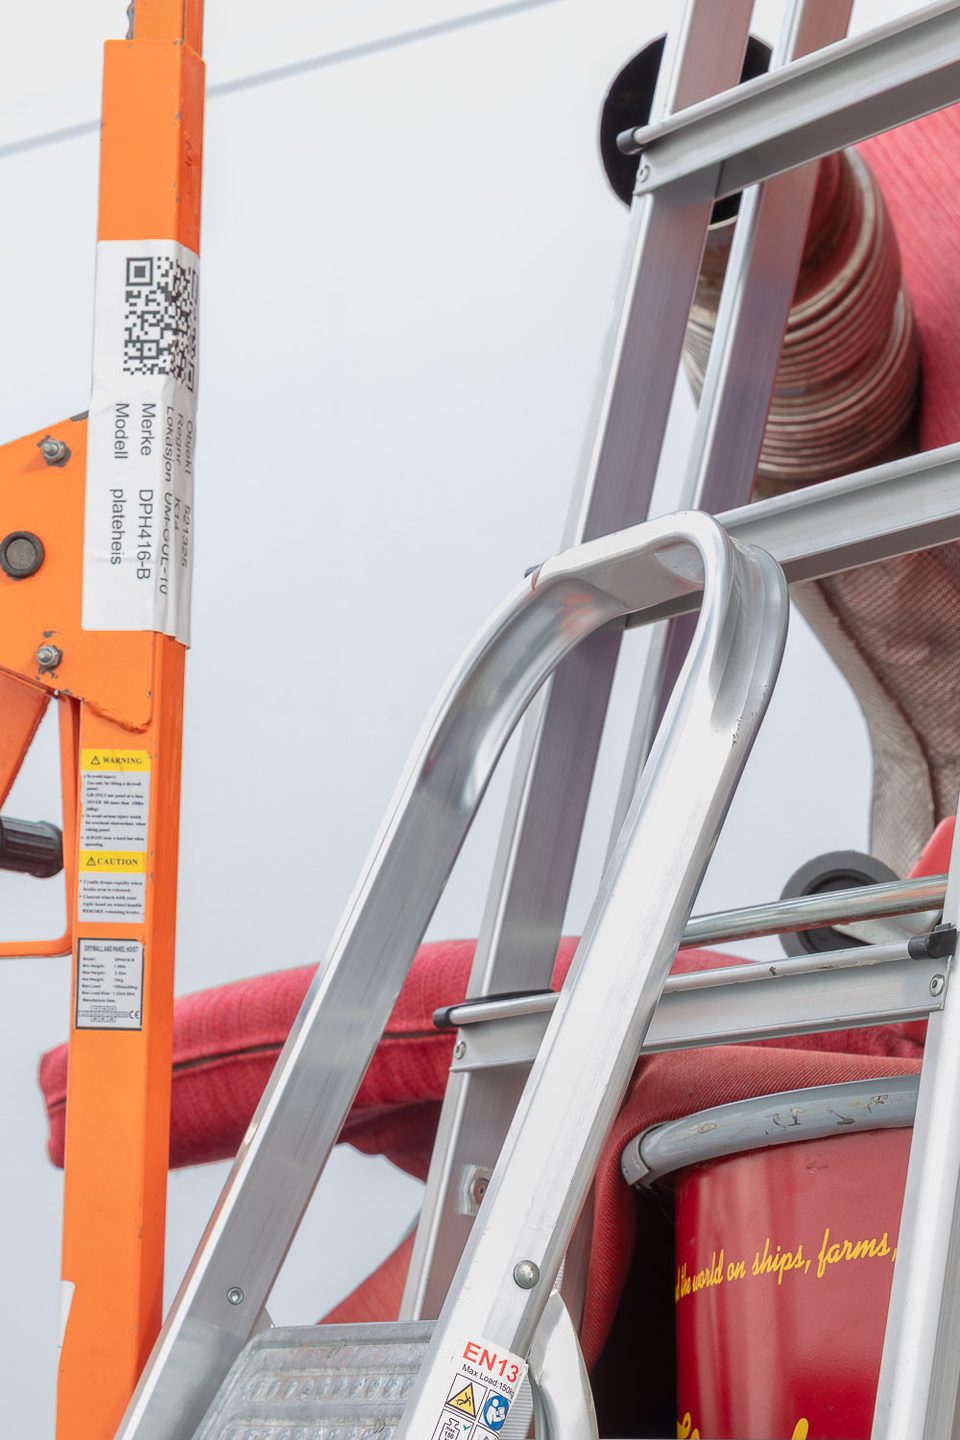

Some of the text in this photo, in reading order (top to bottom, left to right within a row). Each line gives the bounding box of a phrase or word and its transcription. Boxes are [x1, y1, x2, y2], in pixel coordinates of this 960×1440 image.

[162, 406, 174, 482] Lokasjon
[110, 403, 130, 565] Modell plateheis
[136, 403, 156, 580] Merke DPH416-B
[97, 858, 138, 866] CAUTION
[693, 1250, 724, 1292] world
[728, 1260, 746, 1281] on
[752, 1238, 812, 1285] ships,
[817, 1228, 898, 1279] farms,
[462, 1364, 478, 1378] Max
